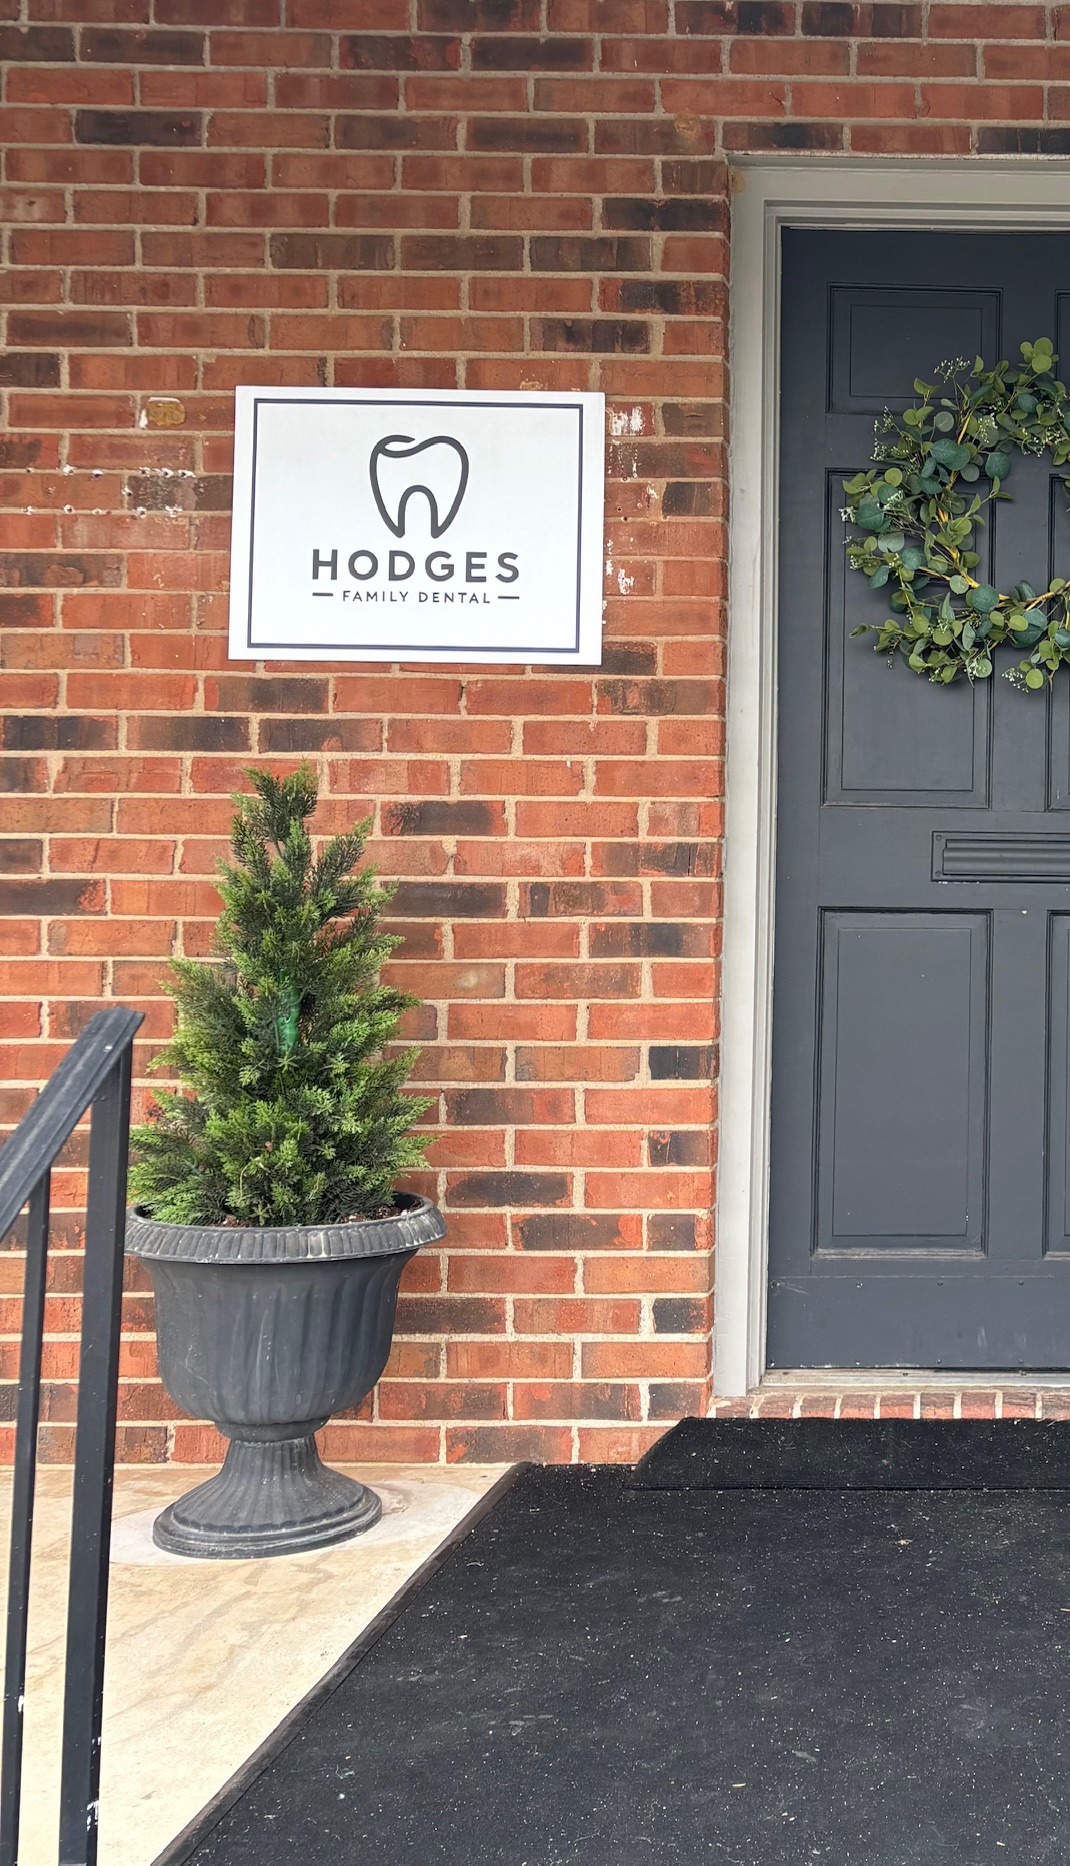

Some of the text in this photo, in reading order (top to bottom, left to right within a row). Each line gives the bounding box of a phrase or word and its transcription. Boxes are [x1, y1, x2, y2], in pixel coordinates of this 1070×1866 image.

[311, 548, 520, 584] HODGES
[342, 590, 491, 604] FAMILY DENTAL
